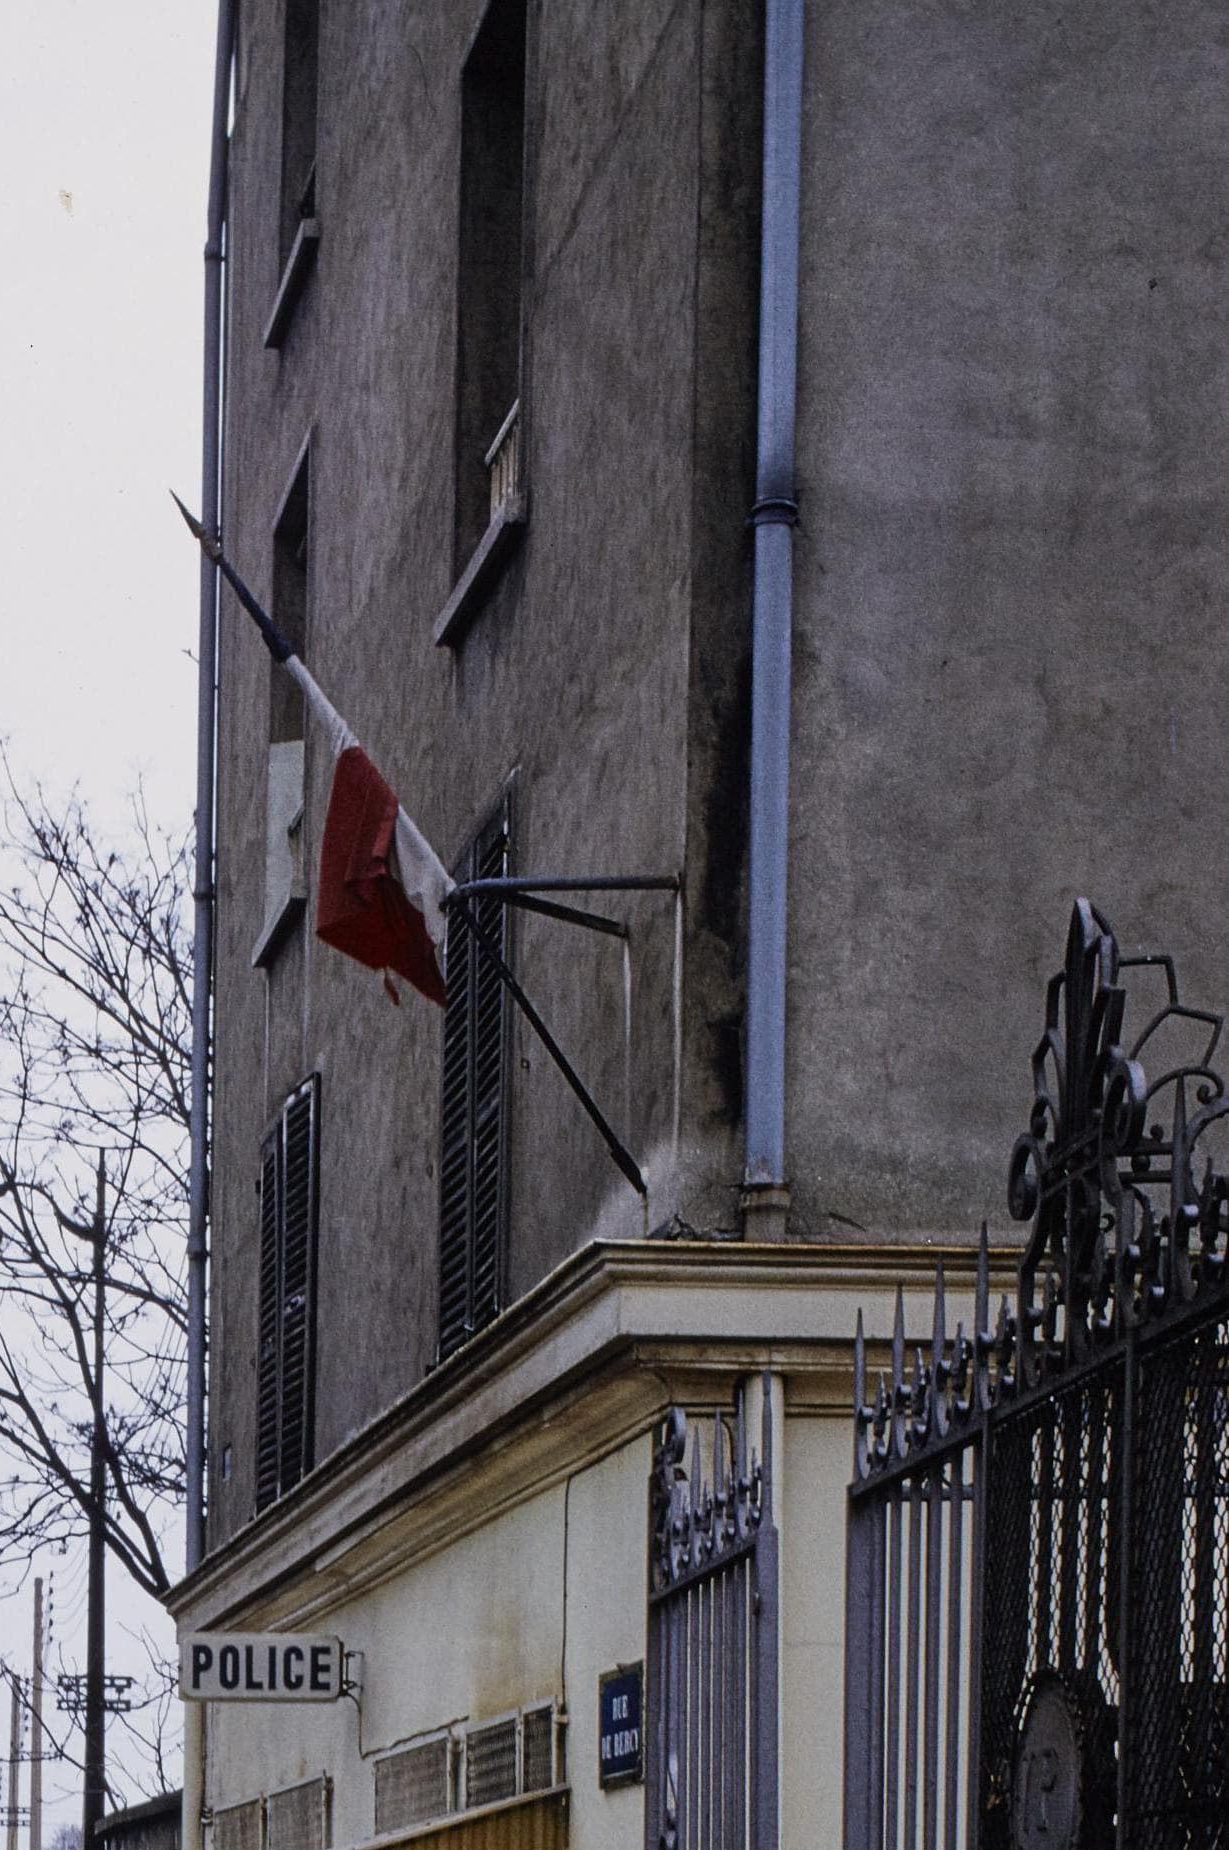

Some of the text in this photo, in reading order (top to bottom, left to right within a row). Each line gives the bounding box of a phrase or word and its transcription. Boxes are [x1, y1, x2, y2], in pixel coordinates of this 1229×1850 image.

[192, 1644, 332, 1691] POLICE
[612, 1694, 629, 1721] RUE
[601, 1728, 639, 1760] DE BERCY
